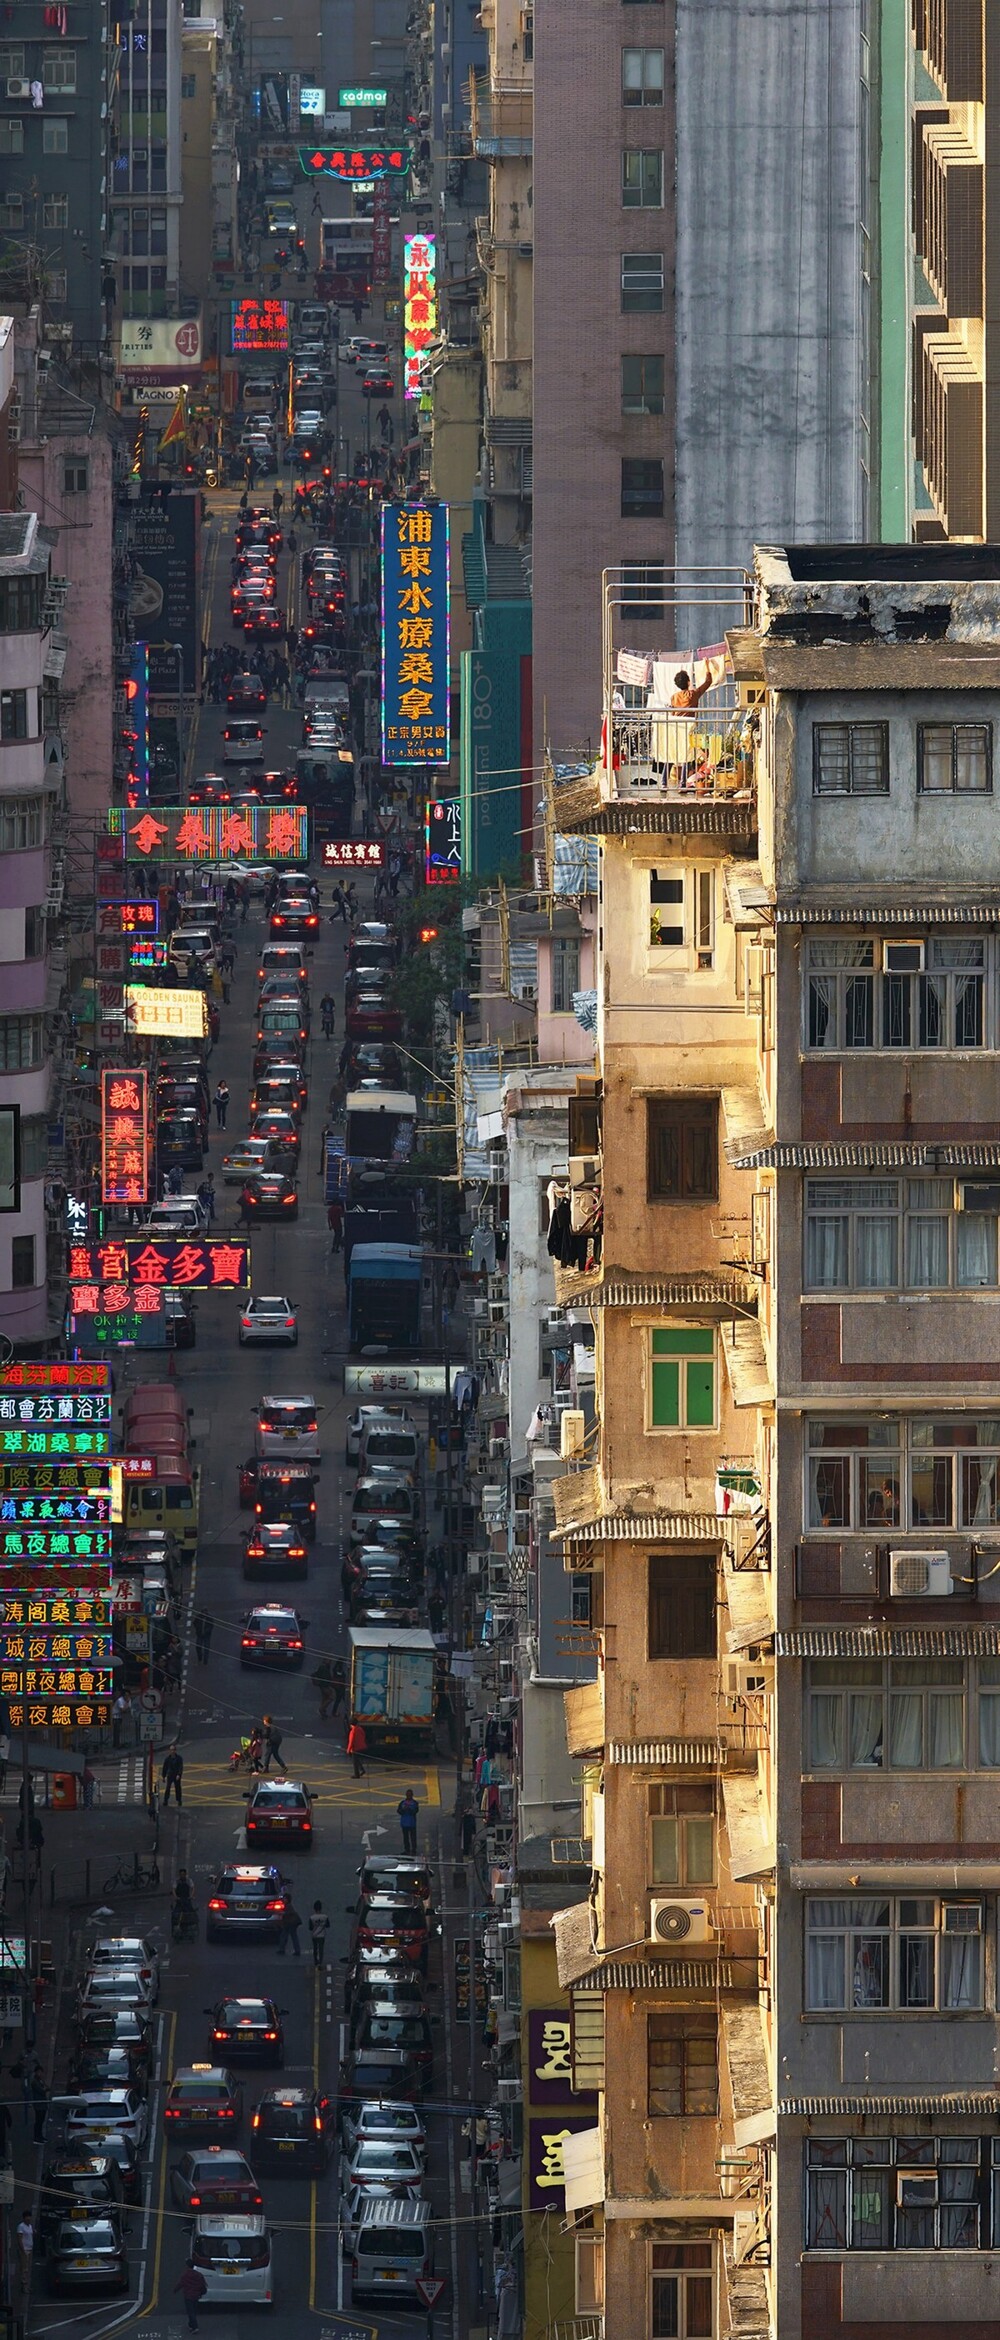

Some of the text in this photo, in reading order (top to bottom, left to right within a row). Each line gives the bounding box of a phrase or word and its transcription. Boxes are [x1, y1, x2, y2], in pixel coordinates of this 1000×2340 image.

[397, 509, 434, 721] 浦東水療桑拿
[325, 843, 381, 859] 誠信賓館
[136, 991, 170, 1002] GOLDEN
[172, 993, 201, 1003] SAUNA
[130, 1245, 245, 1284] 金多寶
[368, 1373, 410, 1391] 喜記
[0, 1398, 107, 1420] 都會芬蘭浴 11/F
[3, 1432, 107, 1453] 翠湖桑拿 9/F
[1, 1499, 108, 1520] 蘋果夜總會 6/F
[3, 1533, 107, 1554] 馬夜總會 5/F
[5, 1602, 105, 1622] 涛阁桑拿 3
[5, 1638, 94, 1659] 城夜總會
[1, 1672, 107, 1692] 國際夜總會 1/F
[9, 1705, 94, 1726] 際夜總會
